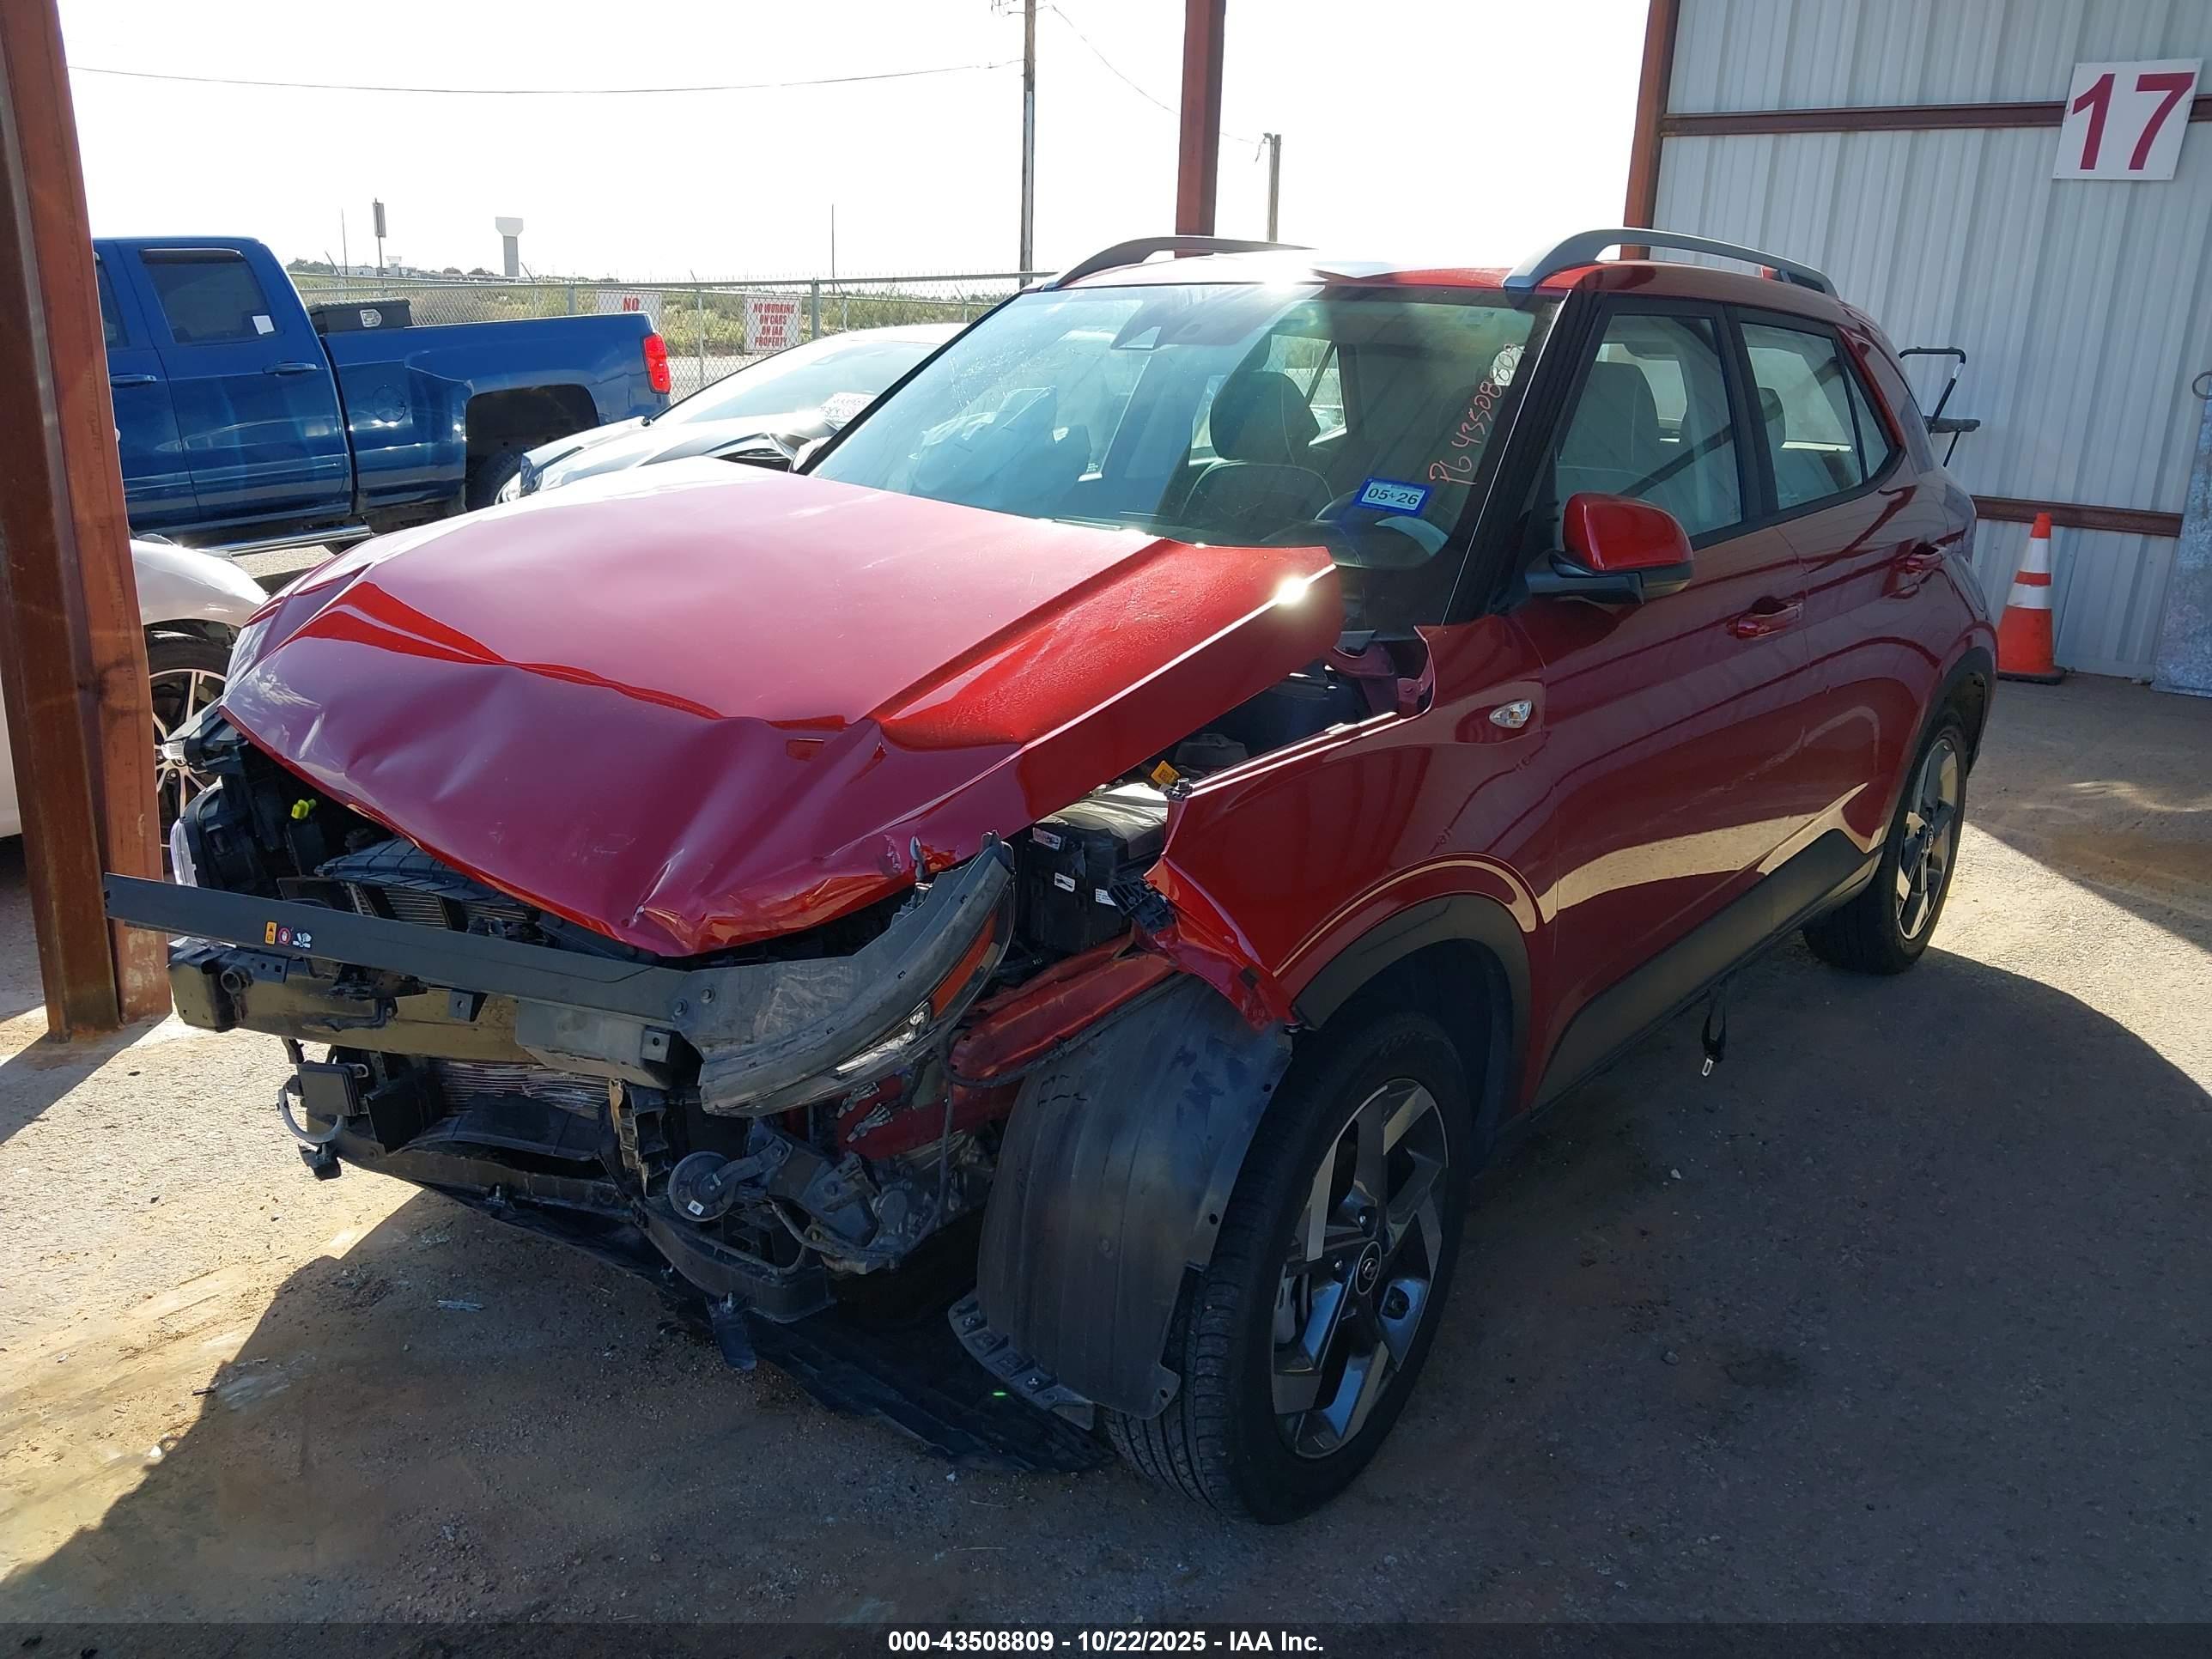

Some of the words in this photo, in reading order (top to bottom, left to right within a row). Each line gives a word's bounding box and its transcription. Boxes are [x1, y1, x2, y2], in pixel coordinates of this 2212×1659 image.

[2072, 71, 2196, 170] 17
[623, 296, 640, 312] NO
[753, 302, 763, 313] NO
[763, 303, 795, 314] WORKING
[759, 314, 769, 325] ON
[770, 314, 787, 325] CARS
[762, 325, 771, 336] ON
[754, 337, 787, 348] PROPERTY
